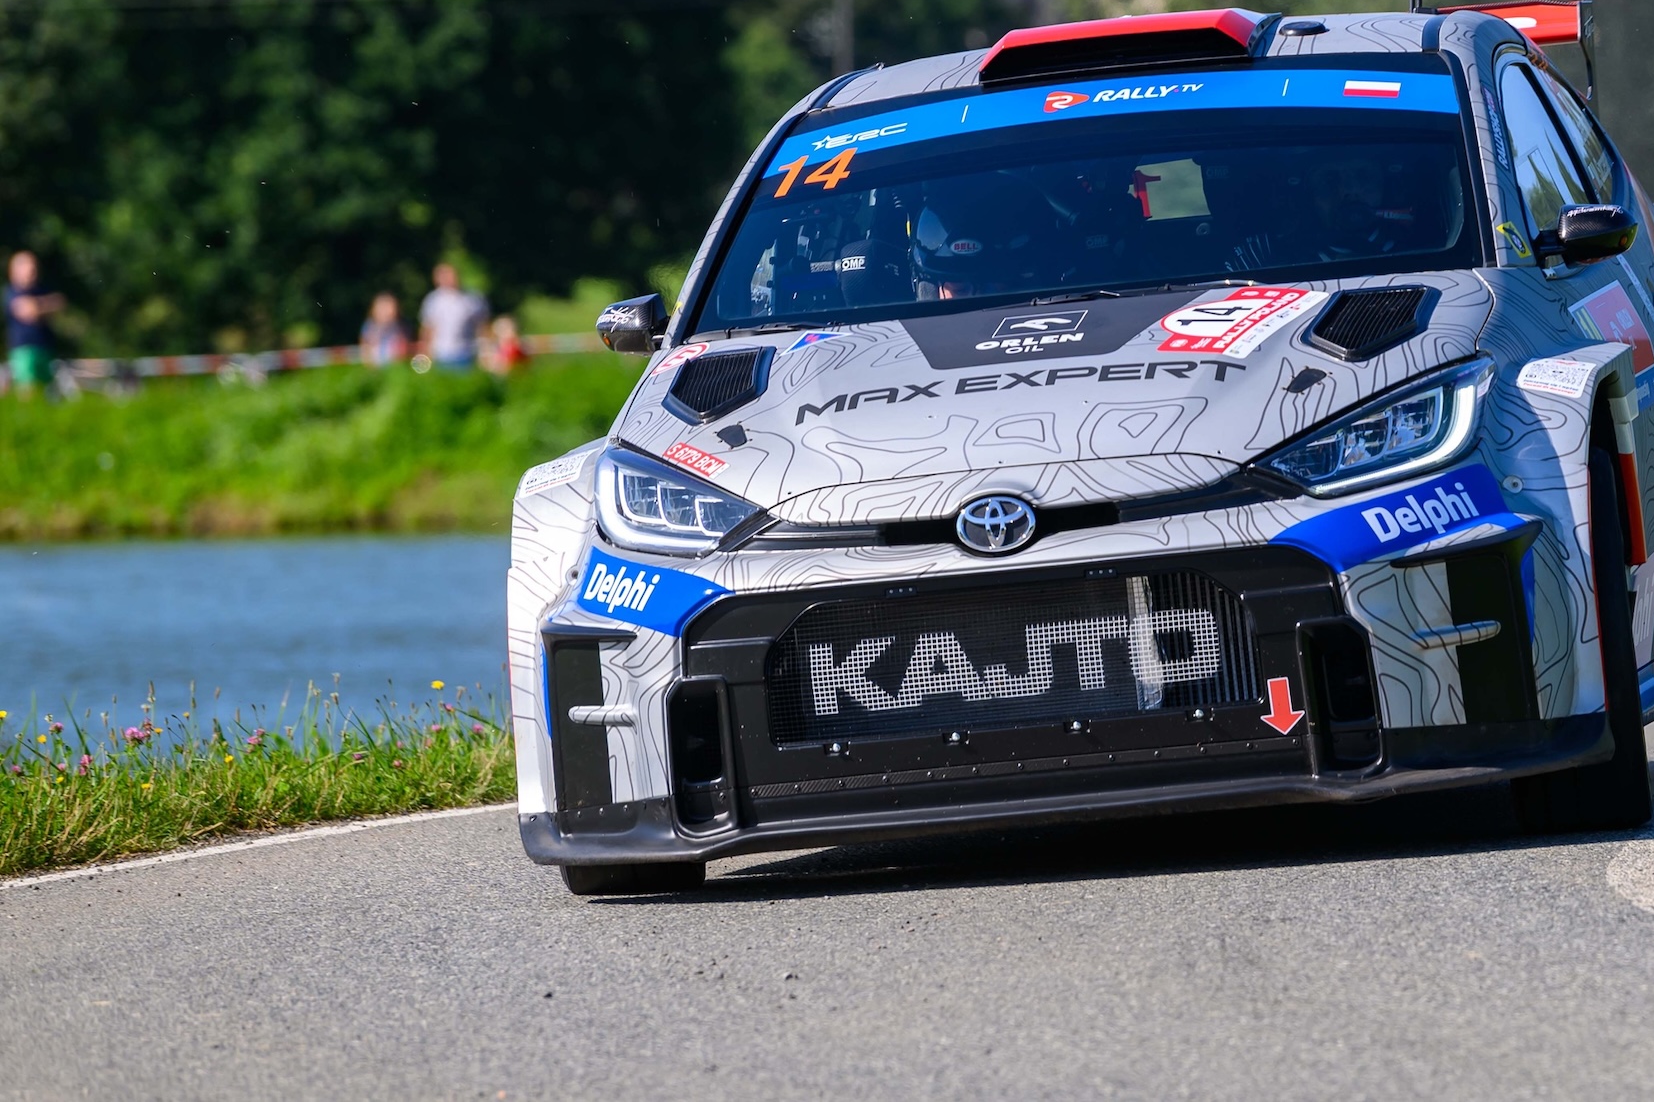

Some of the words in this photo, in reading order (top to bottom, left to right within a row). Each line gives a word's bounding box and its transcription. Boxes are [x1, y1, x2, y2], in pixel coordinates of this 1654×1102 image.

[818, 123, 907, 150] ERC
[774, 148, 857, 199] 14
[842, 257, 866, 271] OMP
[953, 243, 977, 251] BELL
[1177, 306, 1253, 326] 14
[1212, 317, 1254, 349] RALLY
[1251, 292, 1300, 322] POLAND
[975, 333, 1084, 350] ORLEN
[1005, 345, 1044, 354] OIL
[795, 380, 945, 426] MAX
[955, 360, 1247, 394] EXPERT
[1360, 482, 1480, 543] Delphi
[583, 562, 661, 613] Delphi
[809, 609, 1221, 716] KAJTO
